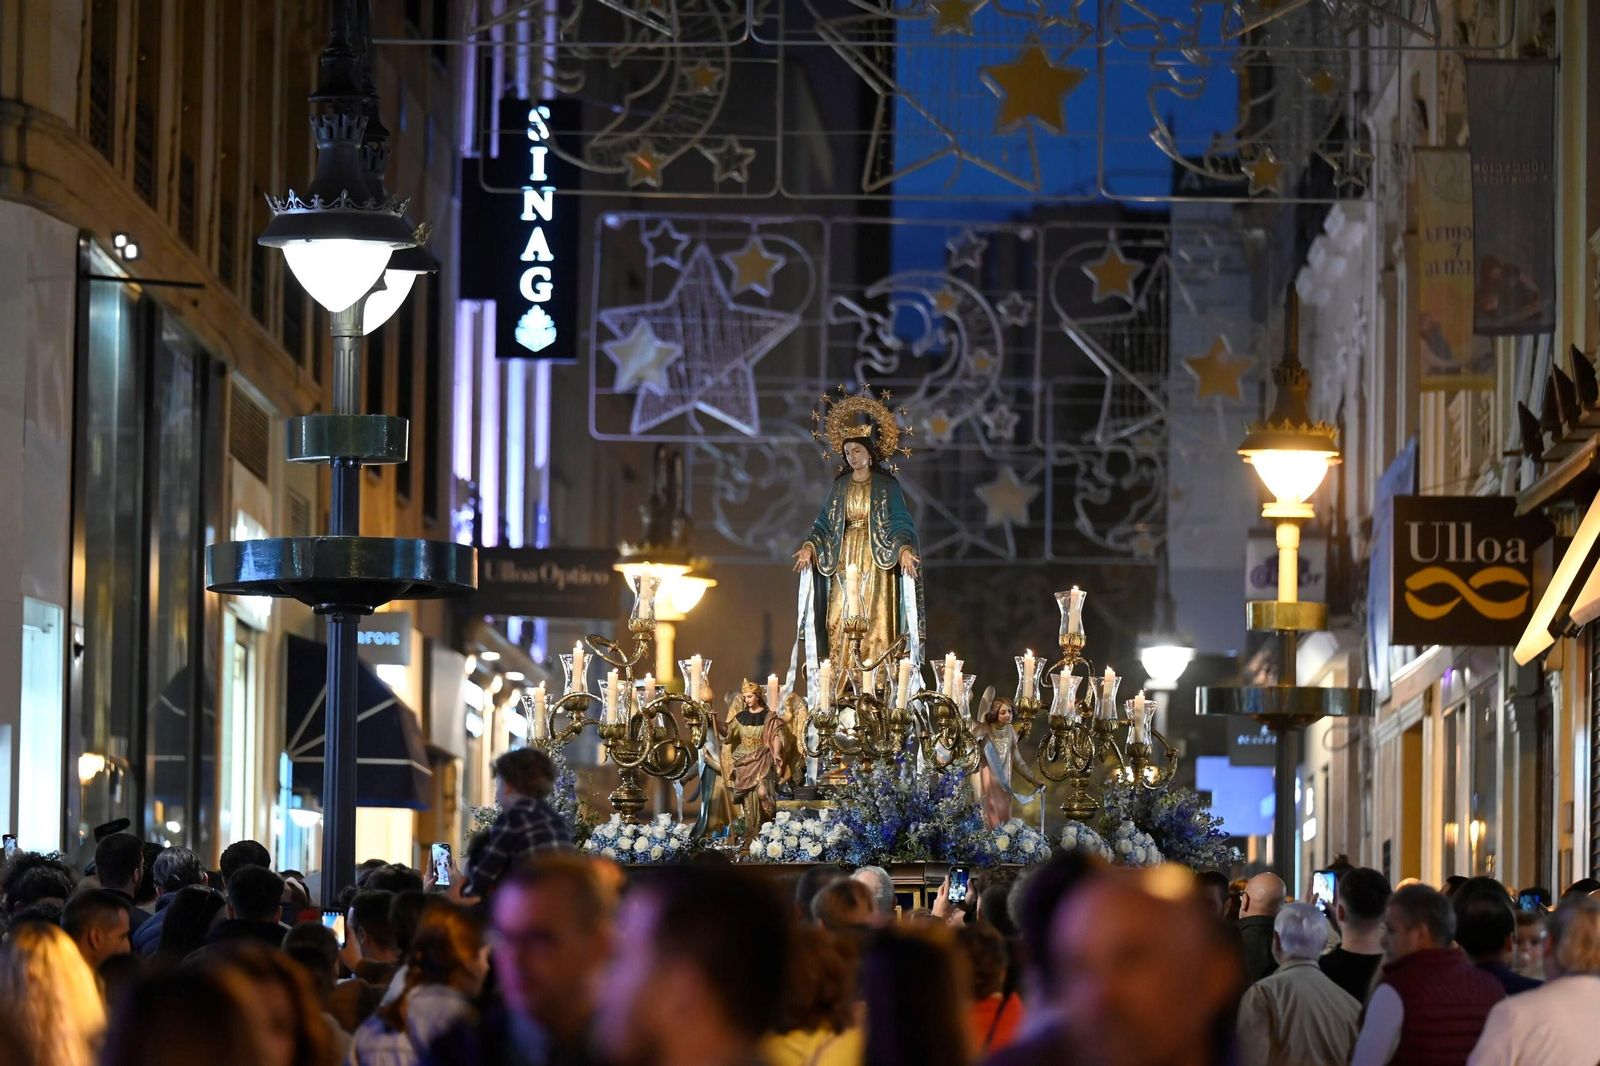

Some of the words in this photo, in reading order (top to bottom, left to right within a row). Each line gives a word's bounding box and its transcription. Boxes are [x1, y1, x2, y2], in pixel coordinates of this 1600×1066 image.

[519, 105, 556, 303] SINAG
[1404, 521, 1529, 563] Ulloa
[484, 559, 538, 583] Ulloa
